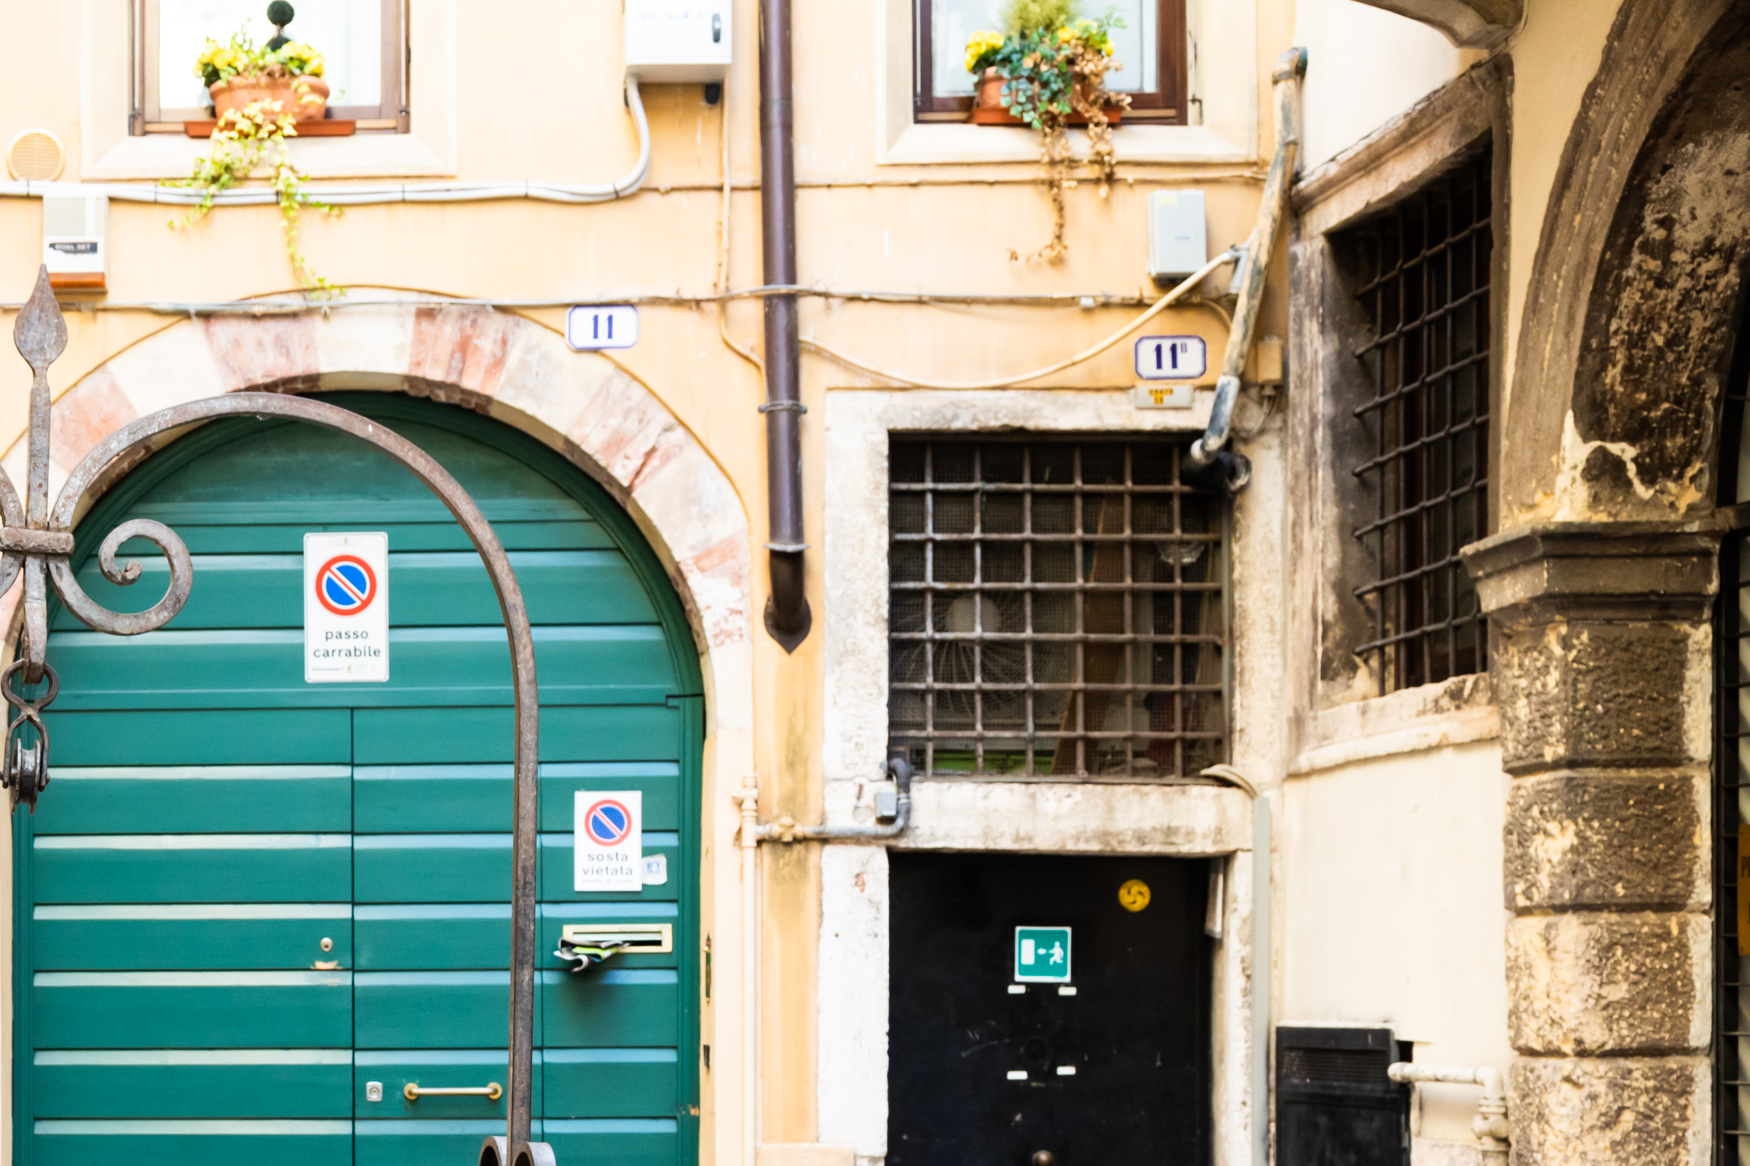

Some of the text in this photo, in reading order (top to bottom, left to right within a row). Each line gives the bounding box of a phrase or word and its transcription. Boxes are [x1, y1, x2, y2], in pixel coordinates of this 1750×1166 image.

[592, 313, 614, 340] 11
[325, 630, 369, 642] passo
[313, 645, 381, 658] carrabile
[587, 852, 628, 862] sosta
[582, 865, 633, 876] vietata
